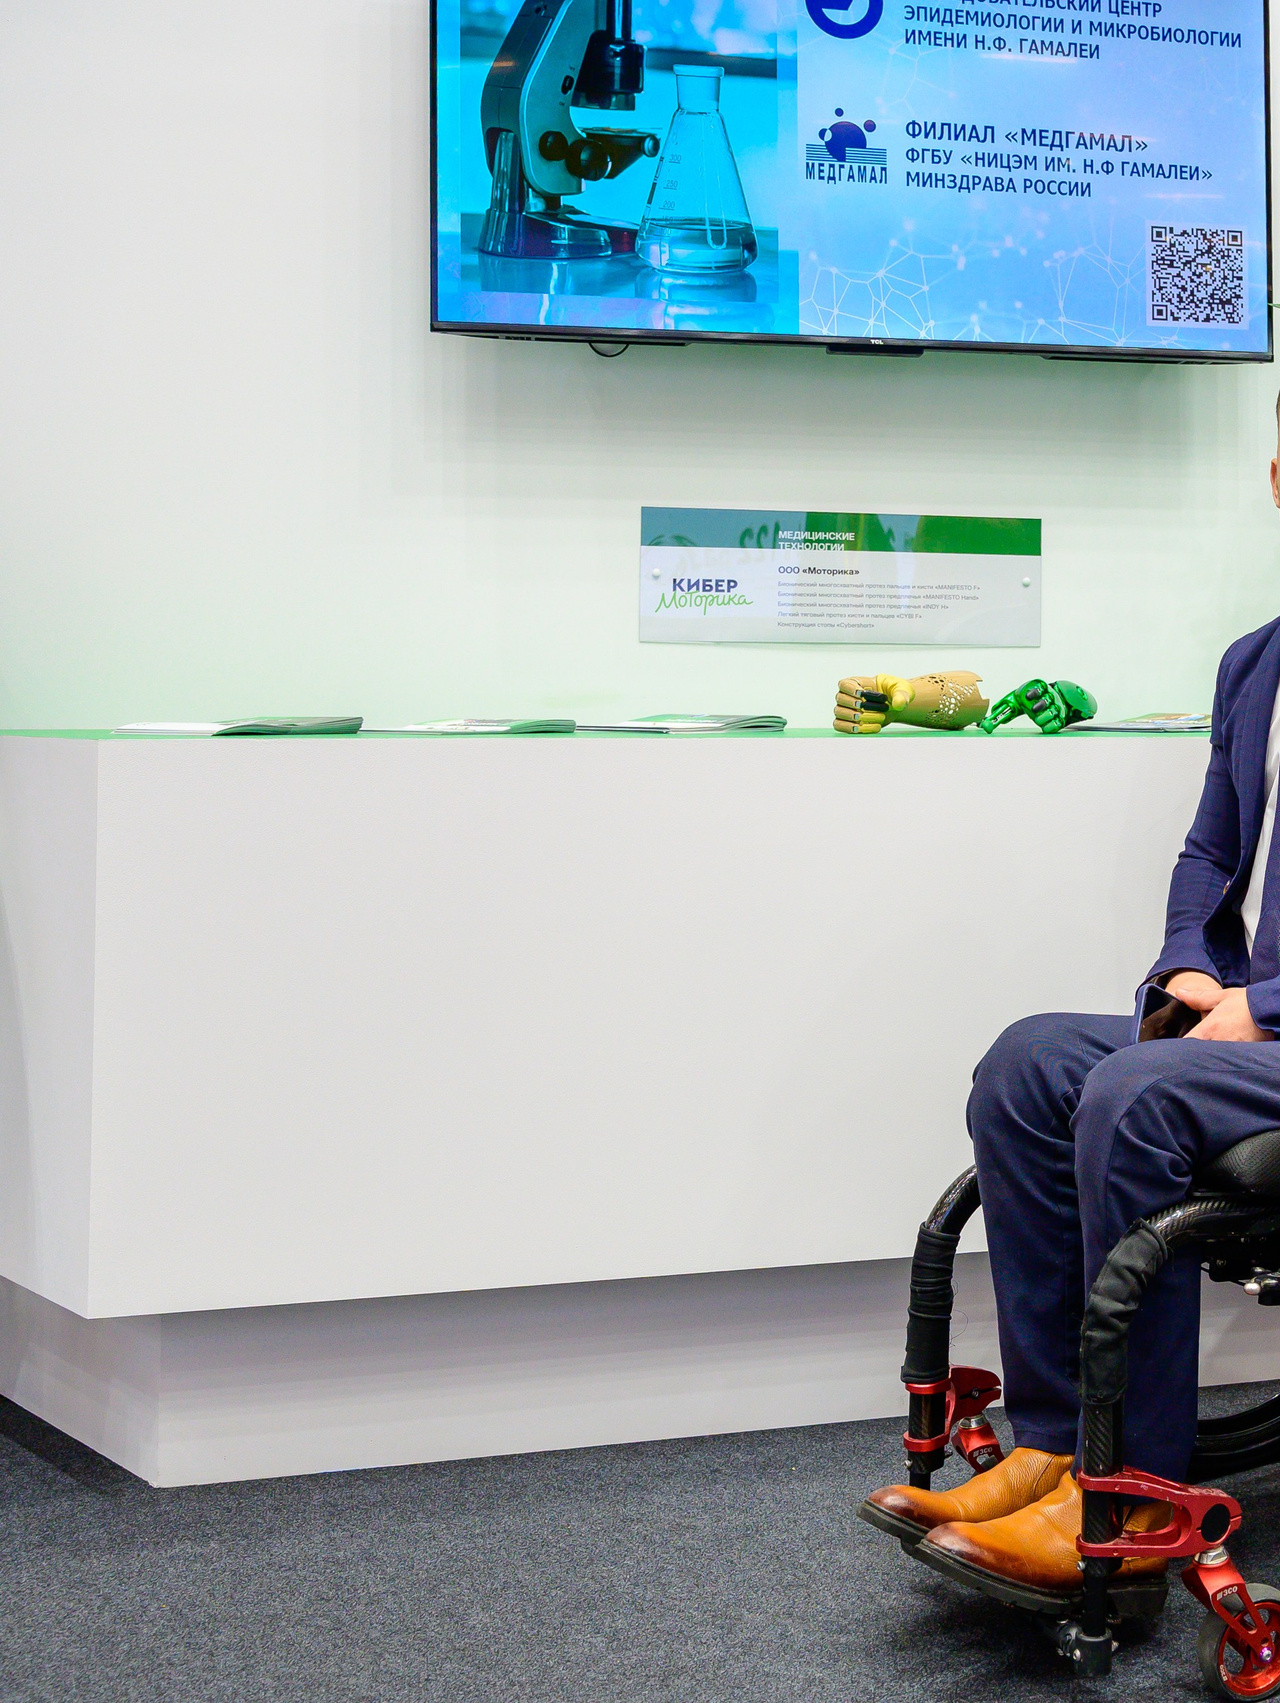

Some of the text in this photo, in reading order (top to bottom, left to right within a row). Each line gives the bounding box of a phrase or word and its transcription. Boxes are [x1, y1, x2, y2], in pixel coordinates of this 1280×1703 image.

[1108, 0, 1163, 17] ЦЕНТР
[904, 5, 1242, 49] ЭПИДЕМИОЛОГИИ И МИКРОБИОЛОГИИ
[905, 28, 1100, 59] ИМЕНИ Н.Ф. ГАМАЛЕИ
[905, 119, 1149, 154] ФИЛИАЛ «МЕДГАМАЛ»
[805, 162, 888, 185] МЕДГАМАЛ
[905, 147, 1213, 182] ФГБУ «НИЦЭМ ИМ. Н.Ф ГАМАЛЕИ»
[905, 172, 1092, 198] МИНЗДРАВА РОССИИ
[778, 531, 855, 541] МЕДИЦИНСКИЕ
[778, 541, 845, 551] ТЕХНОЛОГИИ
[778, 565, 860, 577] ООО «Моторика»
[672, 577, 738, 593] КИБЕР
[654, 591, 754, 616] Моторика
